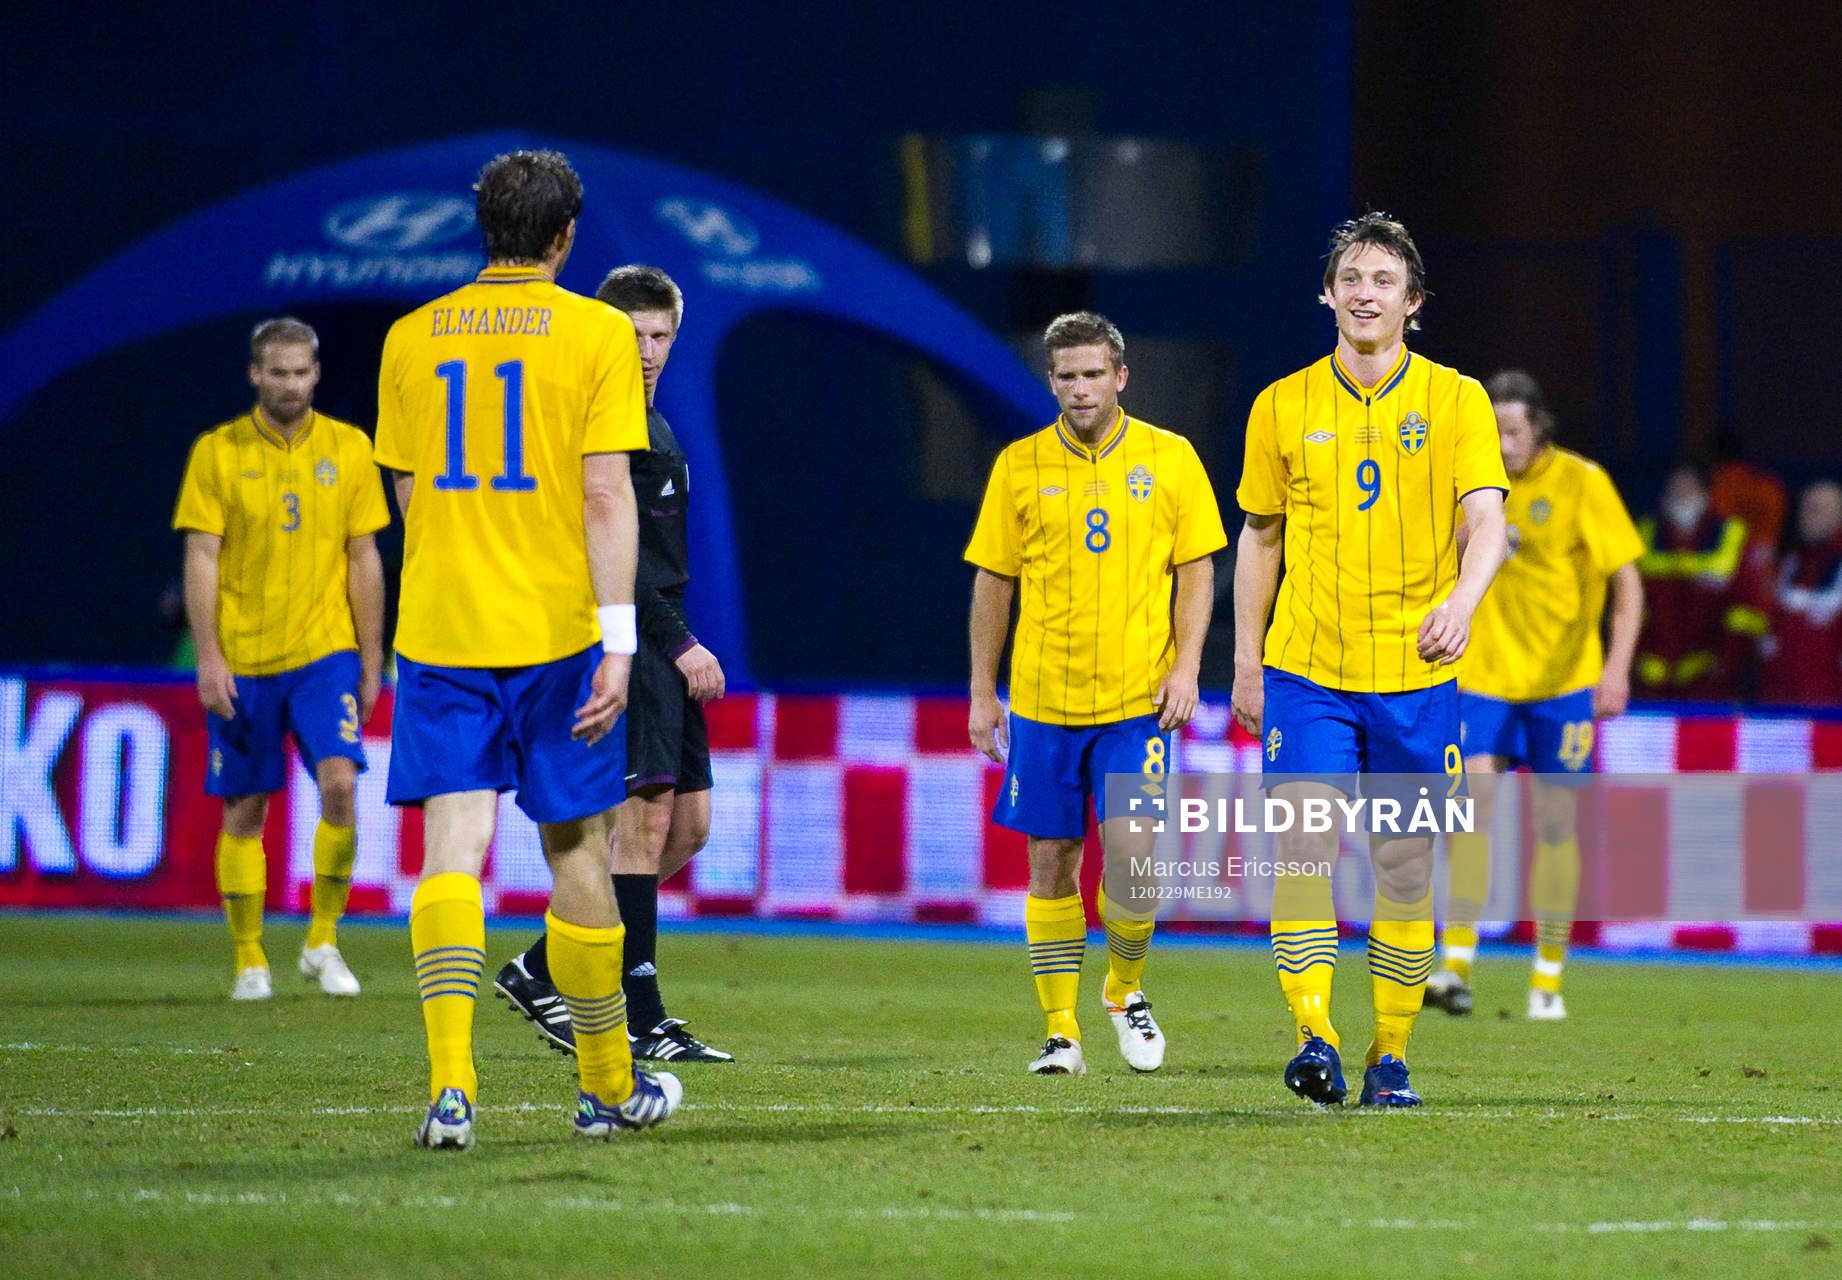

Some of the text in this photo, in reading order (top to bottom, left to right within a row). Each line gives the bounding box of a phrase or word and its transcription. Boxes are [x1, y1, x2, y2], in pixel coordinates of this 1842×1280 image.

[432, 307, 552, 337] ELMANDER
[433, 358, 538, 491] 11
[1356, 458, 1381, 511] 9
[281, 492, 301, 532] 3
[1085, 507, 1111, 554] 8
[339, 692, 359, 732] 3
[1143, 736, 1166, 783] 8
[1443, 743, 1463, 798] 9
